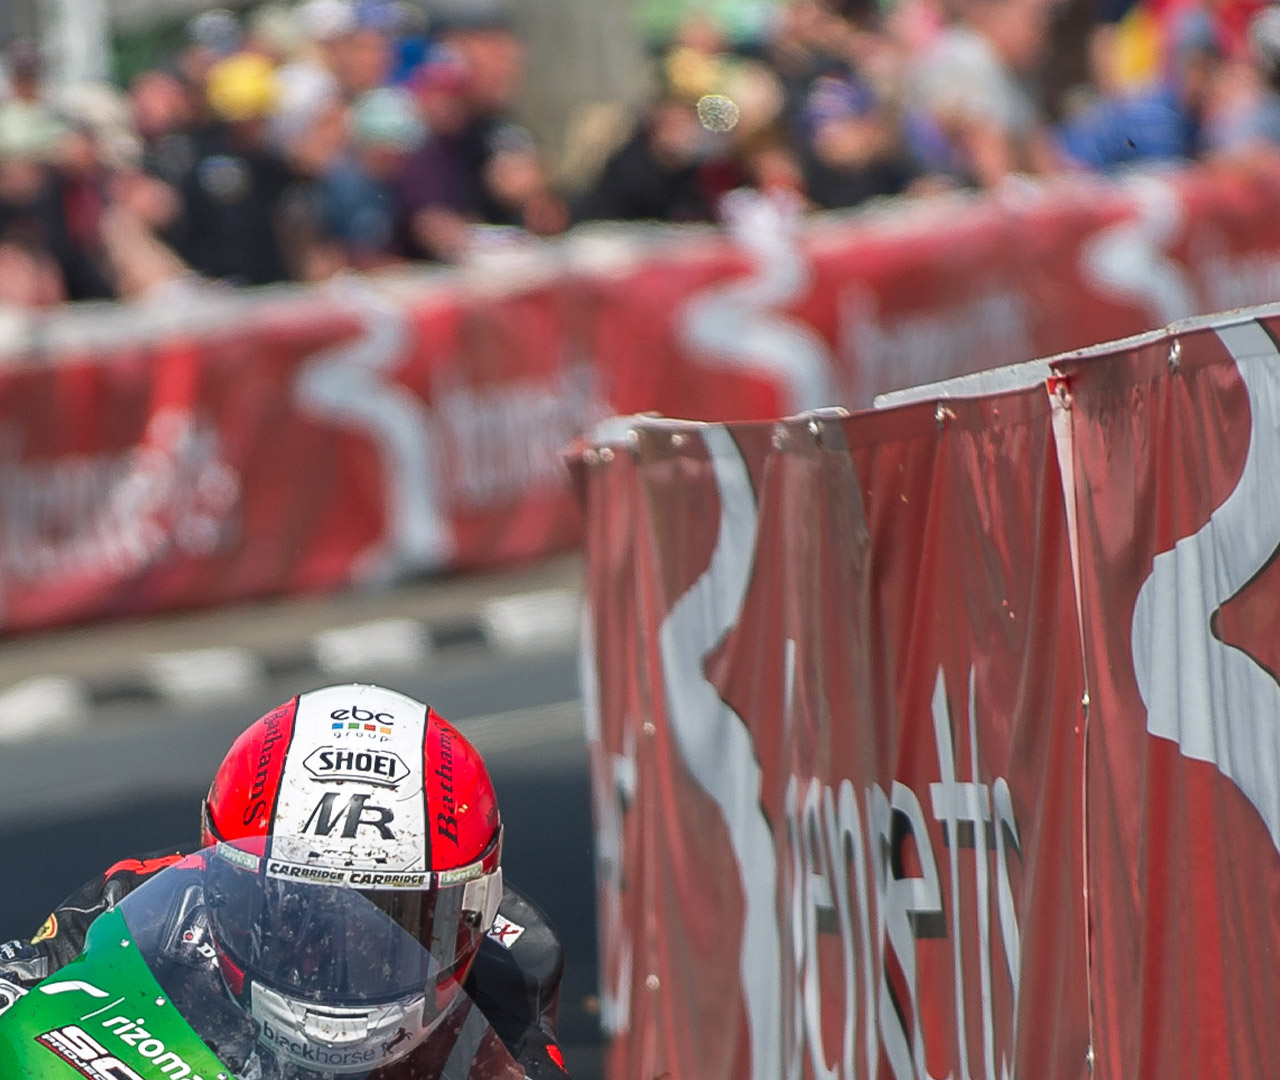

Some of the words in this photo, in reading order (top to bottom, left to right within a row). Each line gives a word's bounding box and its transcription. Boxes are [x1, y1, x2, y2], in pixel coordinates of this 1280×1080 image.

[330, 706, 395, 726] ebc
[333, 731, 389, 742] group
[320, 751, 396, 777] SHOEI
[300, 792, 396, 840] MR
[270, 862, 345, 880] CARBRIDGE
[350, 872, 426, 885] CARBRIDGE
[263, 1020, 376, 1065] blackhorse
